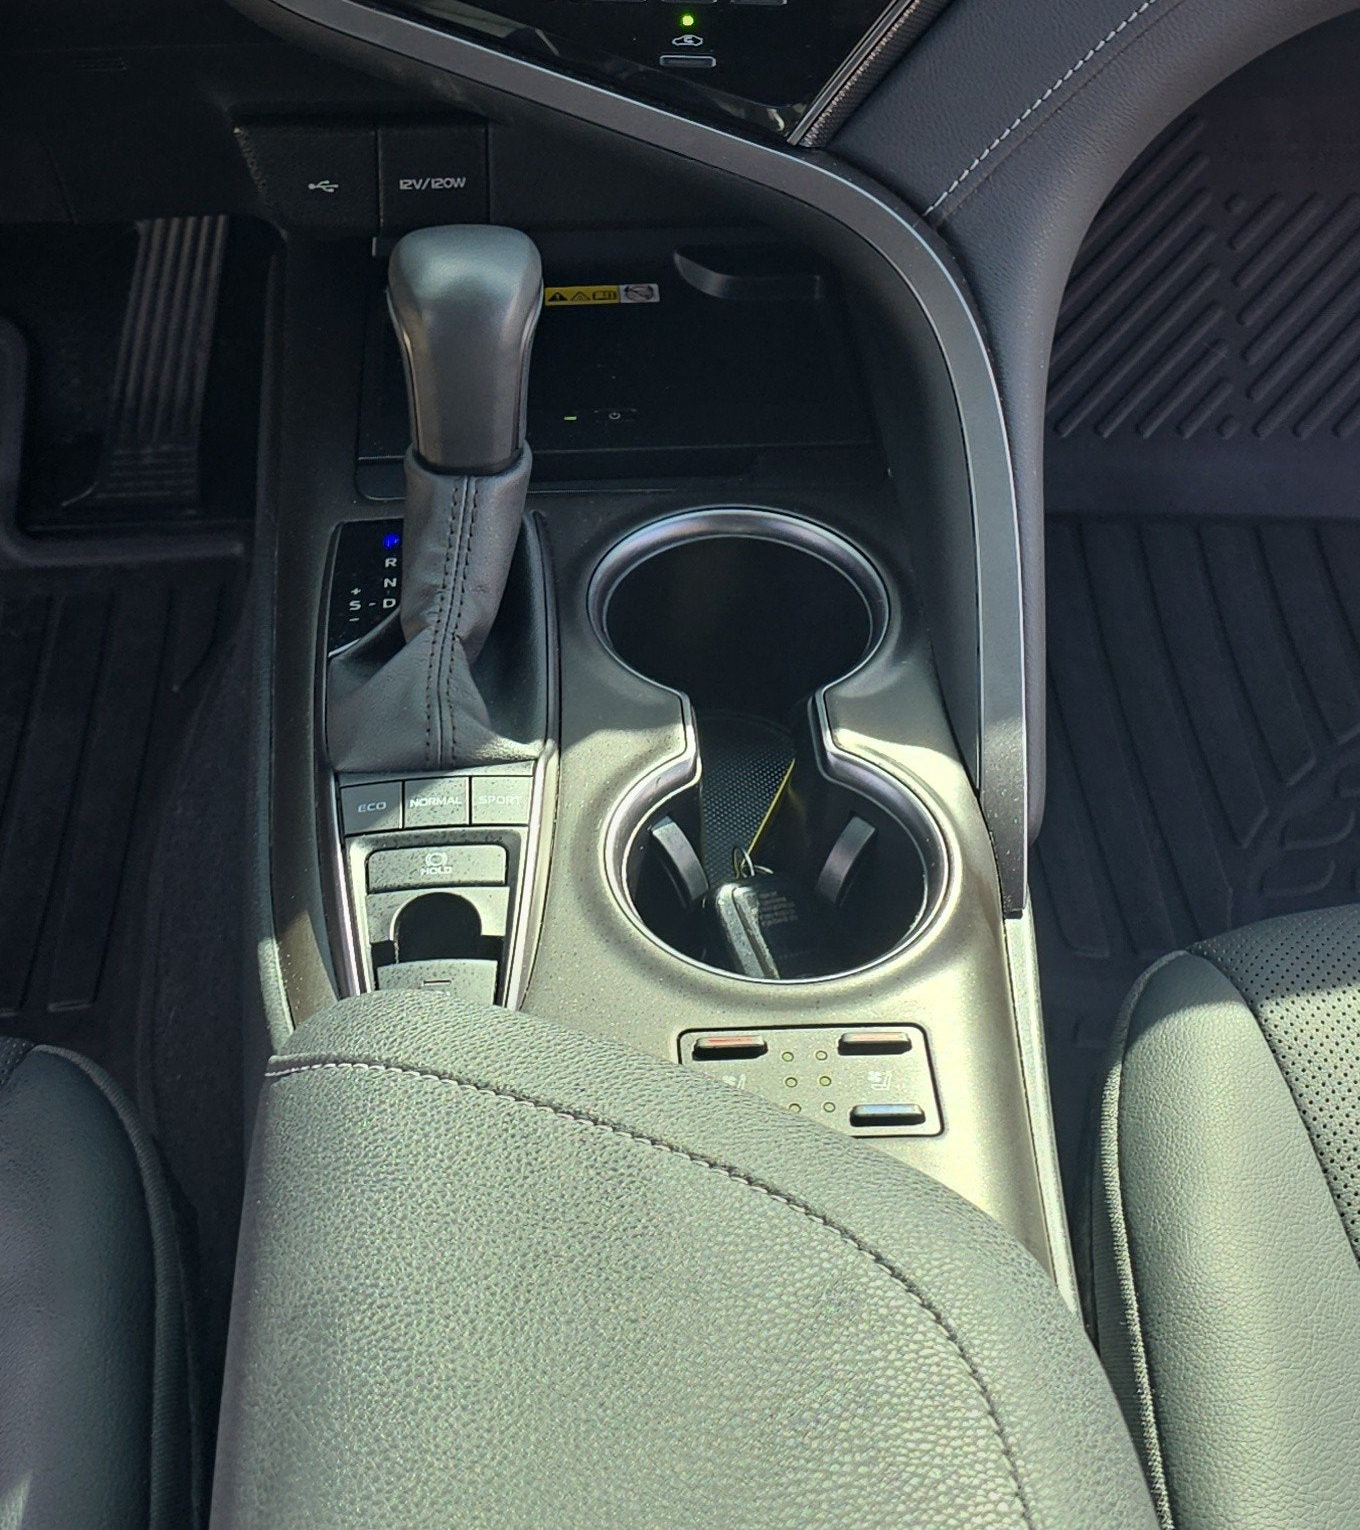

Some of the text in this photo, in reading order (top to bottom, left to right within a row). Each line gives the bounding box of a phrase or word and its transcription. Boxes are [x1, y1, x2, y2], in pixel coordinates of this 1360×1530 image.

[399, 177, 466, 191] 12V/120W
[384, 557, 397, 568] R
[383, 577, 396, 588] N
[349, 600, 361, 611] S
[382, 598, 396, 609] D
[357, 801, 387, 813] ECO
[409, 796, 462, 808] NORMAL
[420, 865, 452, 876] HOLD
